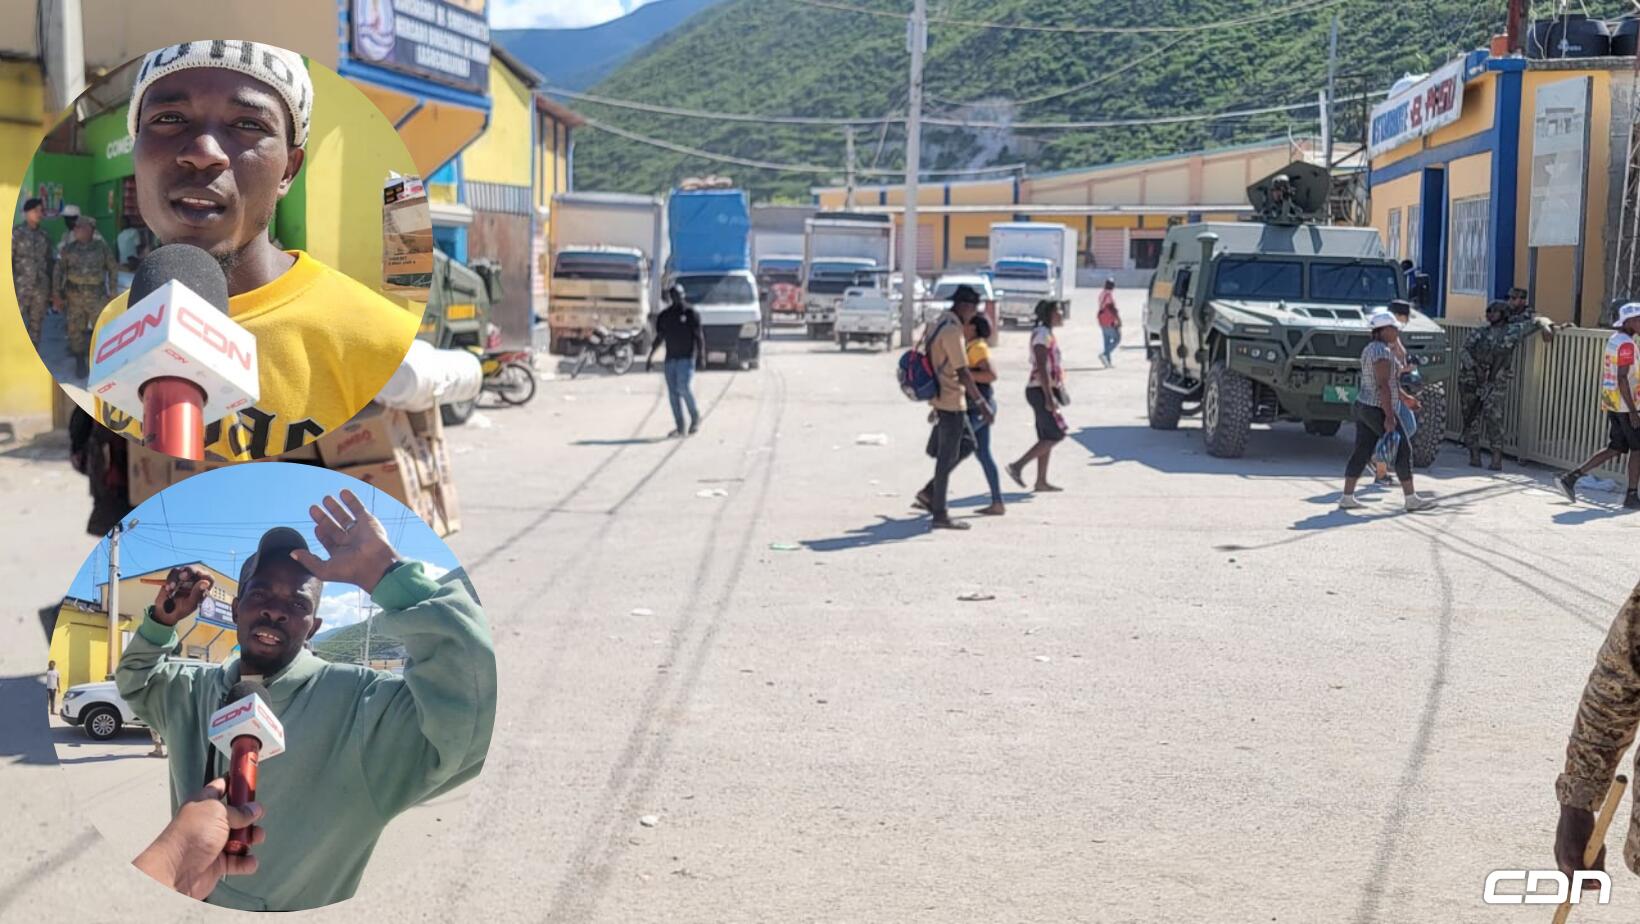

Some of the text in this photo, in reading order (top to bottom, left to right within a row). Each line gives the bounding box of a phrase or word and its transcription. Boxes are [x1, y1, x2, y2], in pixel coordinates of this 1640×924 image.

[95, 304, 165, 364] CDN
[177, 306, 251, 370] CDN
[212, 702, 252, 728] CDN
